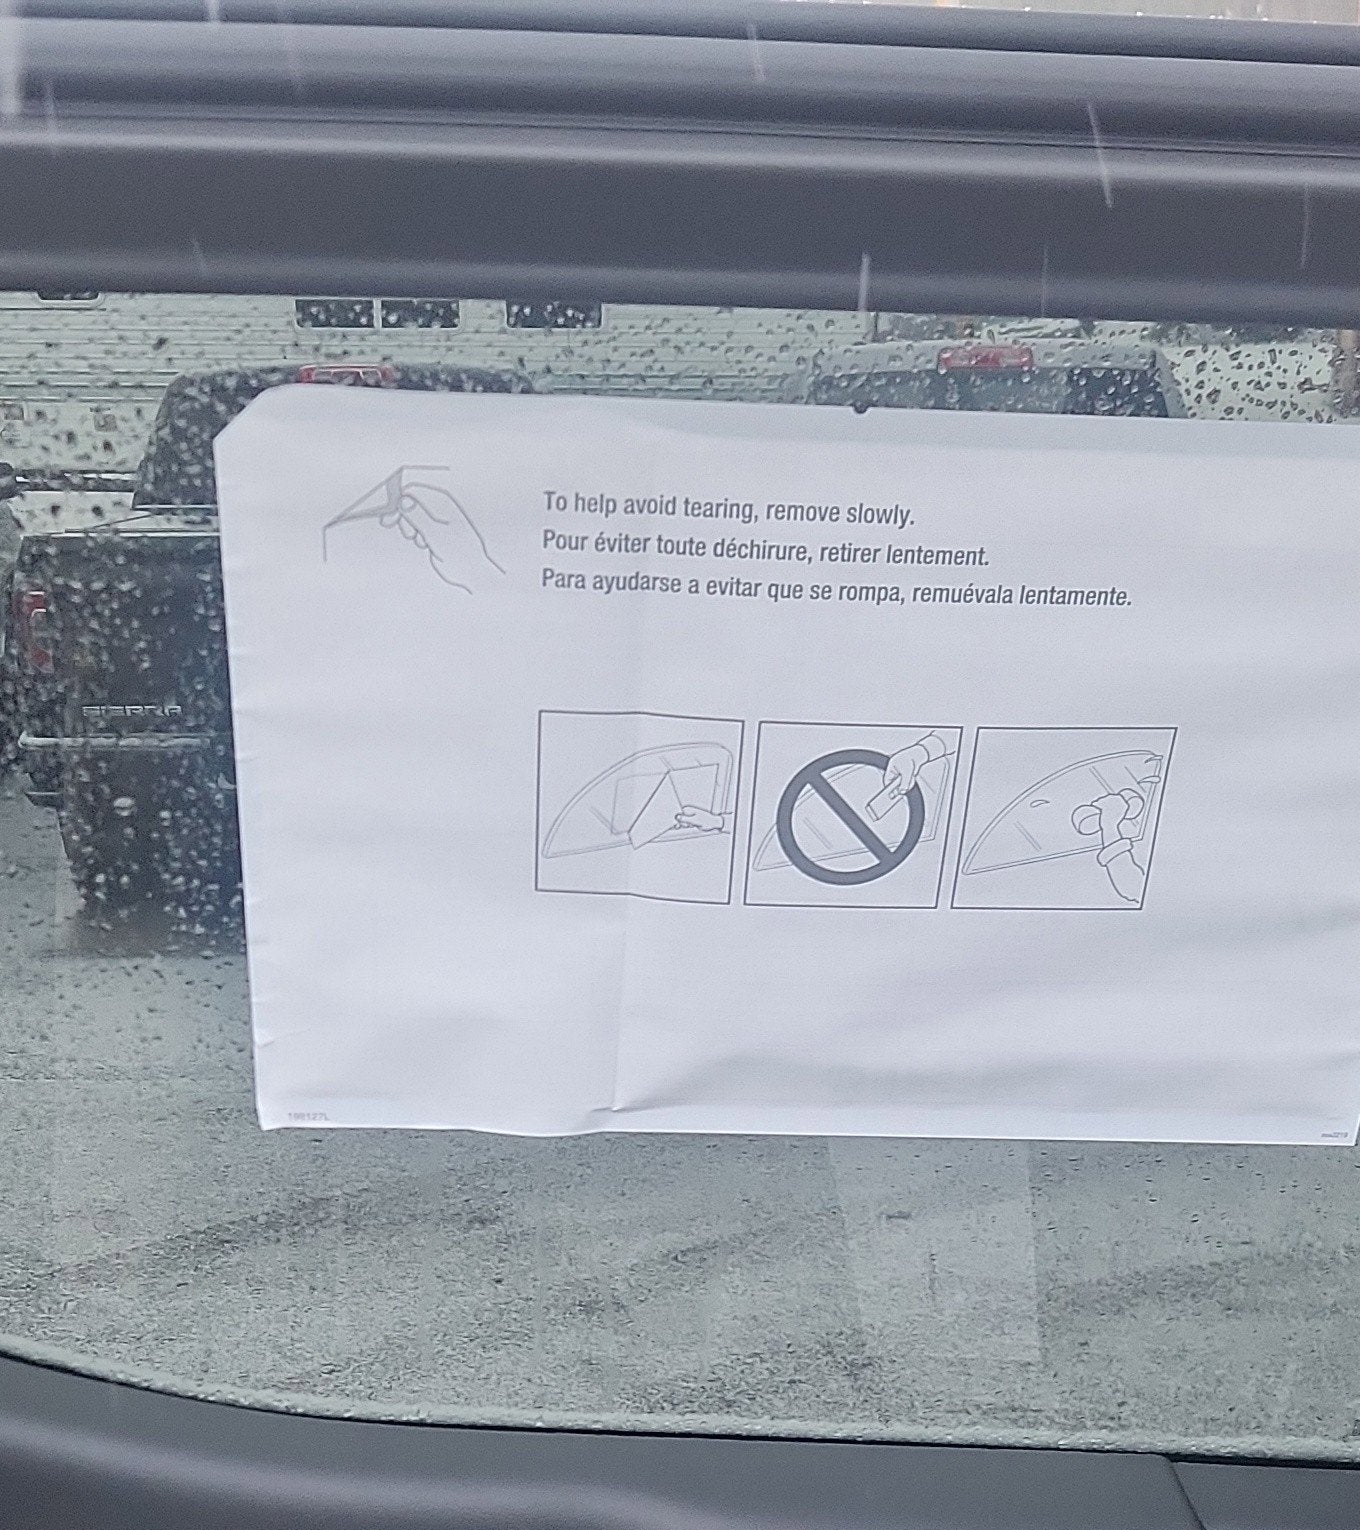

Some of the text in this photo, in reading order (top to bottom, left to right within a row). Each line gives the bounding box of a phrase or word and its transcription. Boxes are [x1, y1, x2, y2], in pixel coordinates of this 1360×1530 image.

[543, 490, 915, 530] To help avoid tearing, remove slowly.
[542, 528, 990, 566] Pour éviter toute déchirure, retirer lentement.
[541, 567, 1132, 606] Para ayudarse a evitar que se rompa, remuévala lentamente.
